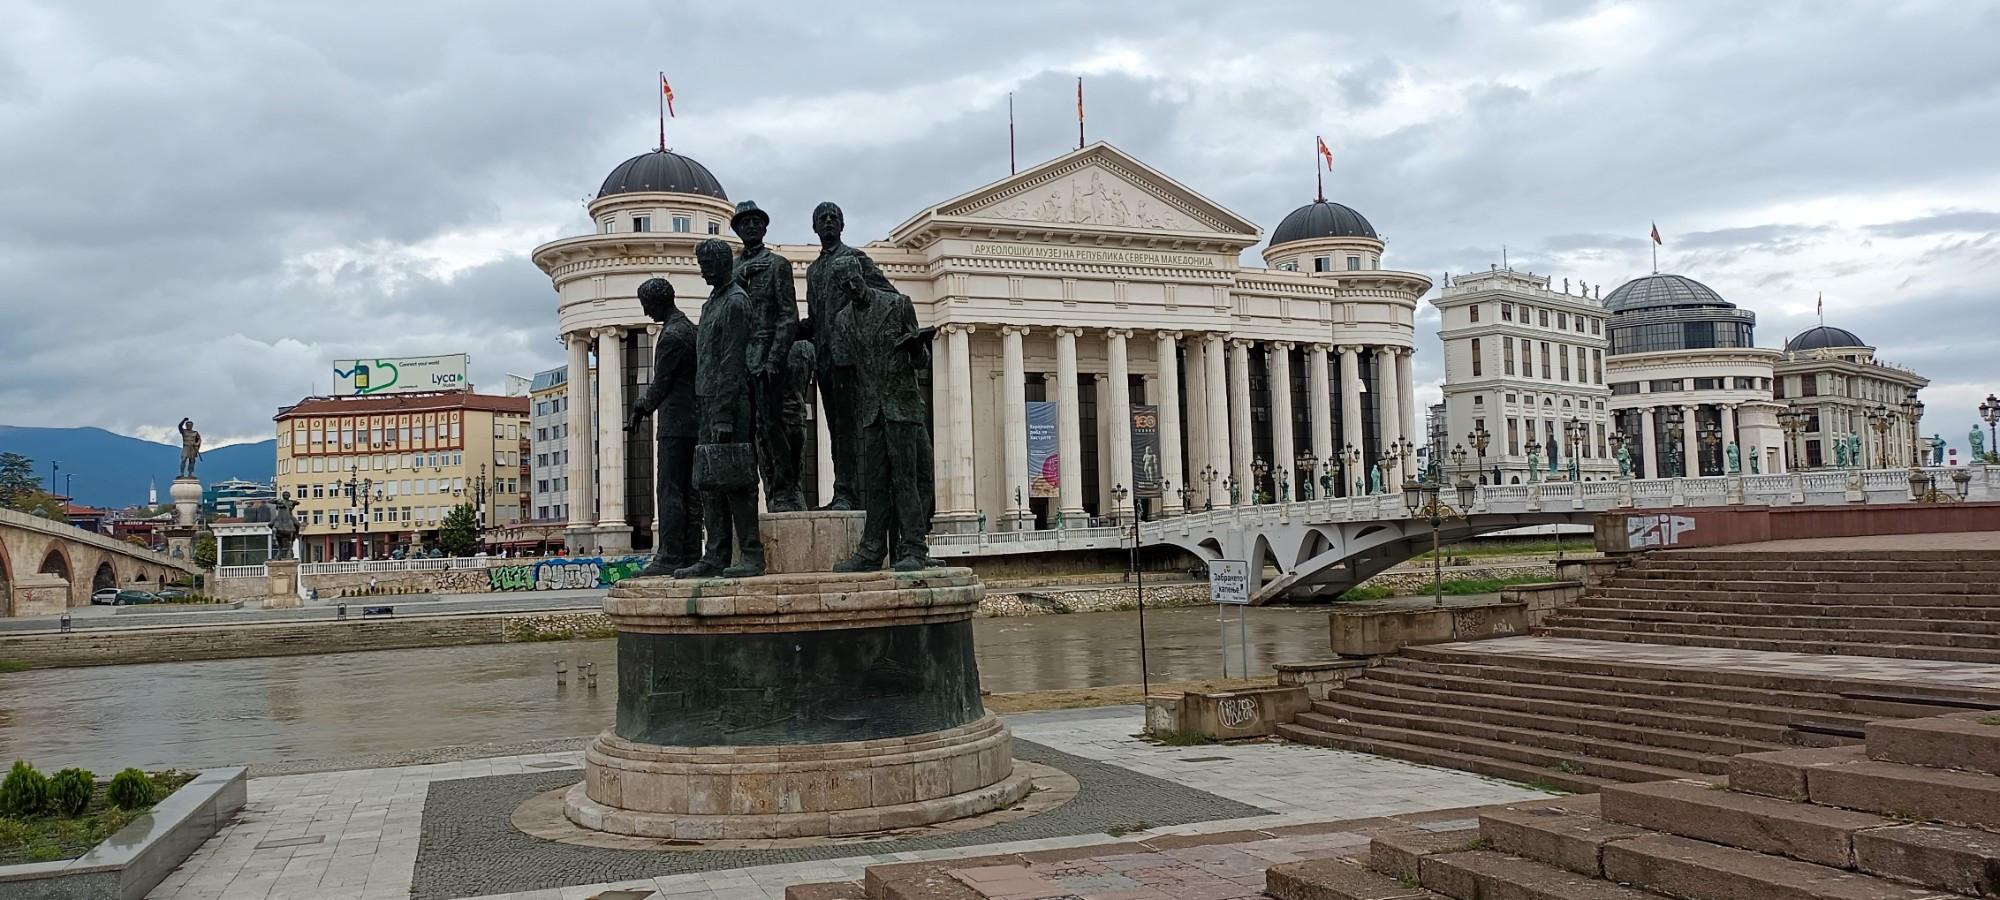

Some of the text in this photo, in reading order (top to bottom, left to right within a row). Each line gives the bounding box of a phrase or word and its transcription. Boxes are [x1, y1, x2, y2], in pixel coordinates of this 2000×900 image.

[975, 244, 1214, 266] АРХЕОЛОШКИ МУЗЕЈ НА РЕПУБЛИКА СЕВЕРНА МАКЕДОНИЈА
[431, 373, 456, 385] Lyca
[1134, 415, 1156, 428] 100
